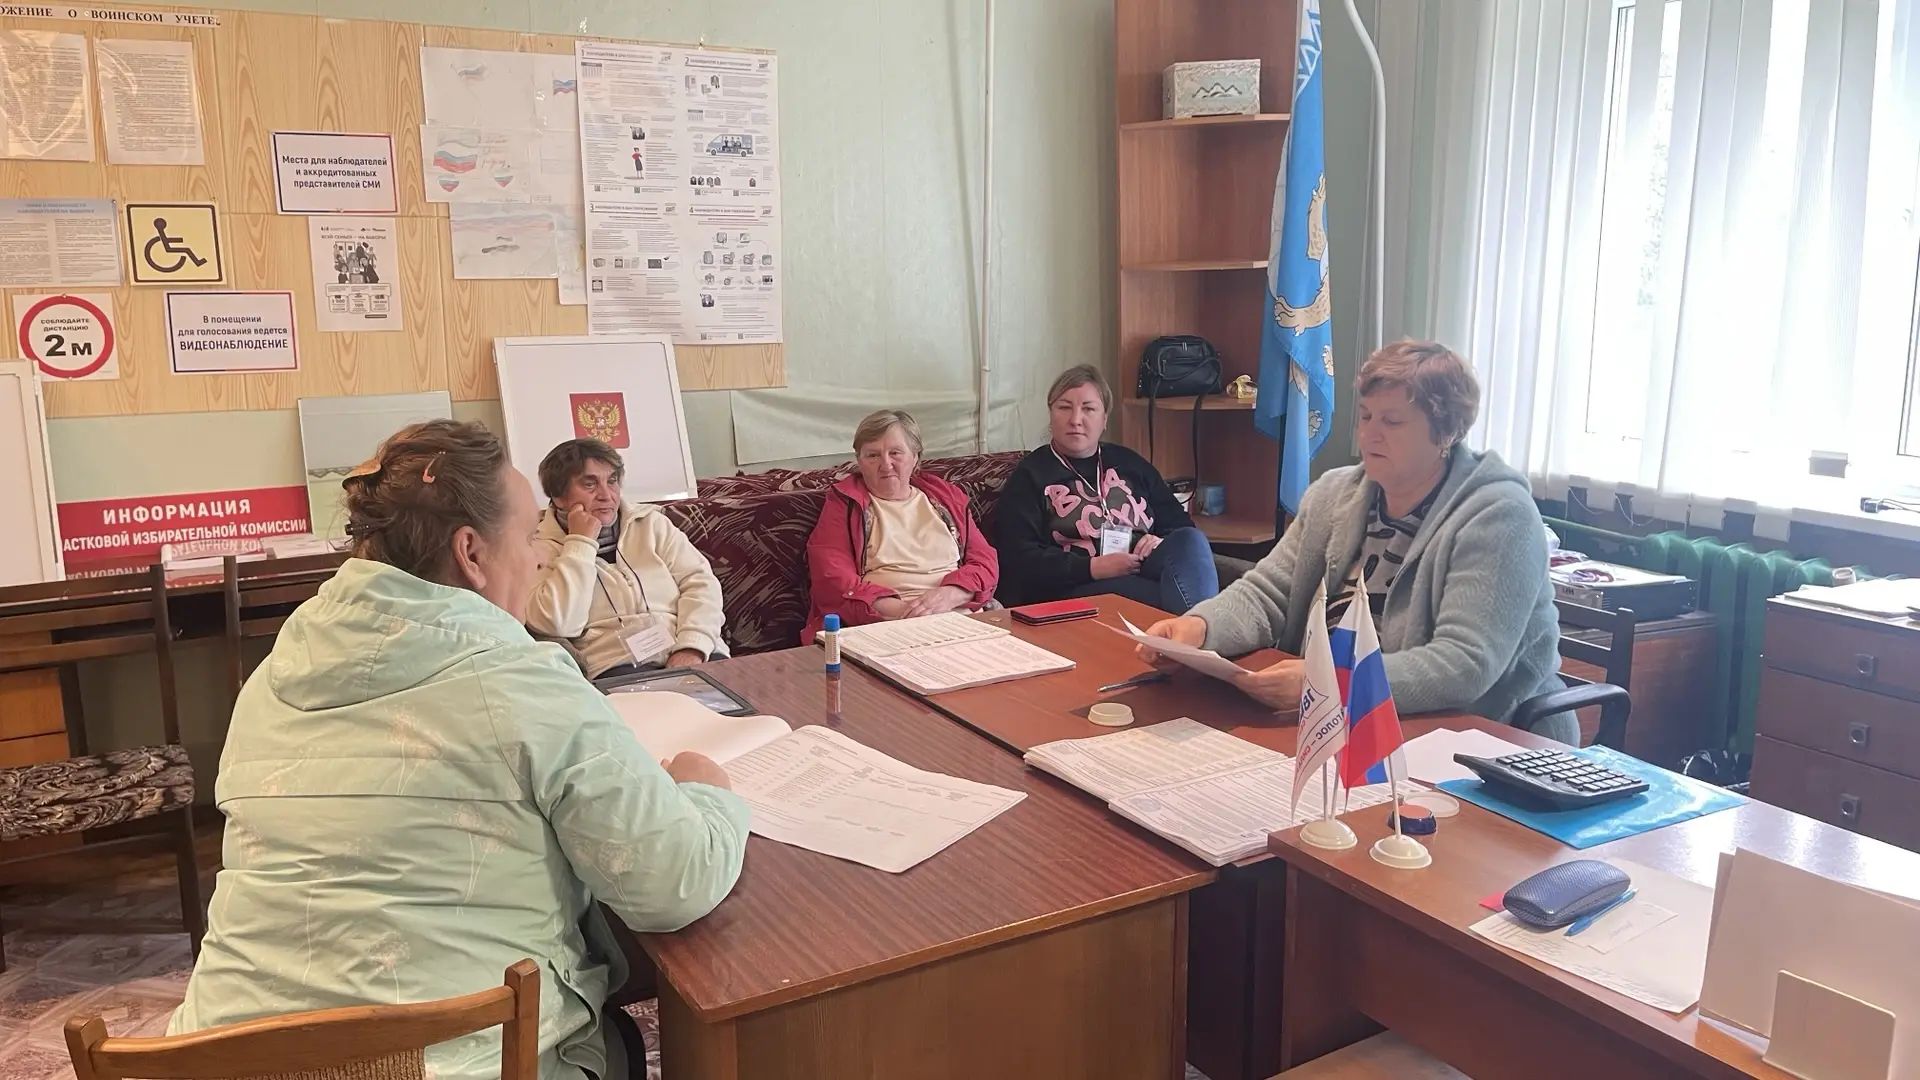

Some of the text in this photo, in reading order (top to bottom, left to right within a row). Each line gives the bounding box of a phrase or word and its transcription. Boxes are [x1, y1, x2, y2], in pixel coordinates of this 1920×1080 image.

[68, 9, 77, 18] О
[91, 10, 163, 23] ВОИНСКОМ
[282, 155, 388, 166] Места для наблюдателей
[303, 168, 377, 177] аккредитованных
[293, 180, 381, 189] представителей СМИ
[40, 317, 90, 325] СОБЛЮДАЙТЕ
[203, 315, 262, 325] В помещении
[178, 326, 288, 337] для голосования ведется
[44, 334, 67, 357] 2
[180, 338, 289, 351] ВИДЕОНАБЛЮДЕНИЕ
[103, 498, 252, 525] ИНФОРМАЦИЯ
[133, 521, 238, 546] ИЗБИРАТЕЛЬНОЙ
[240, 518, 307, 536] КОМИССИИ
